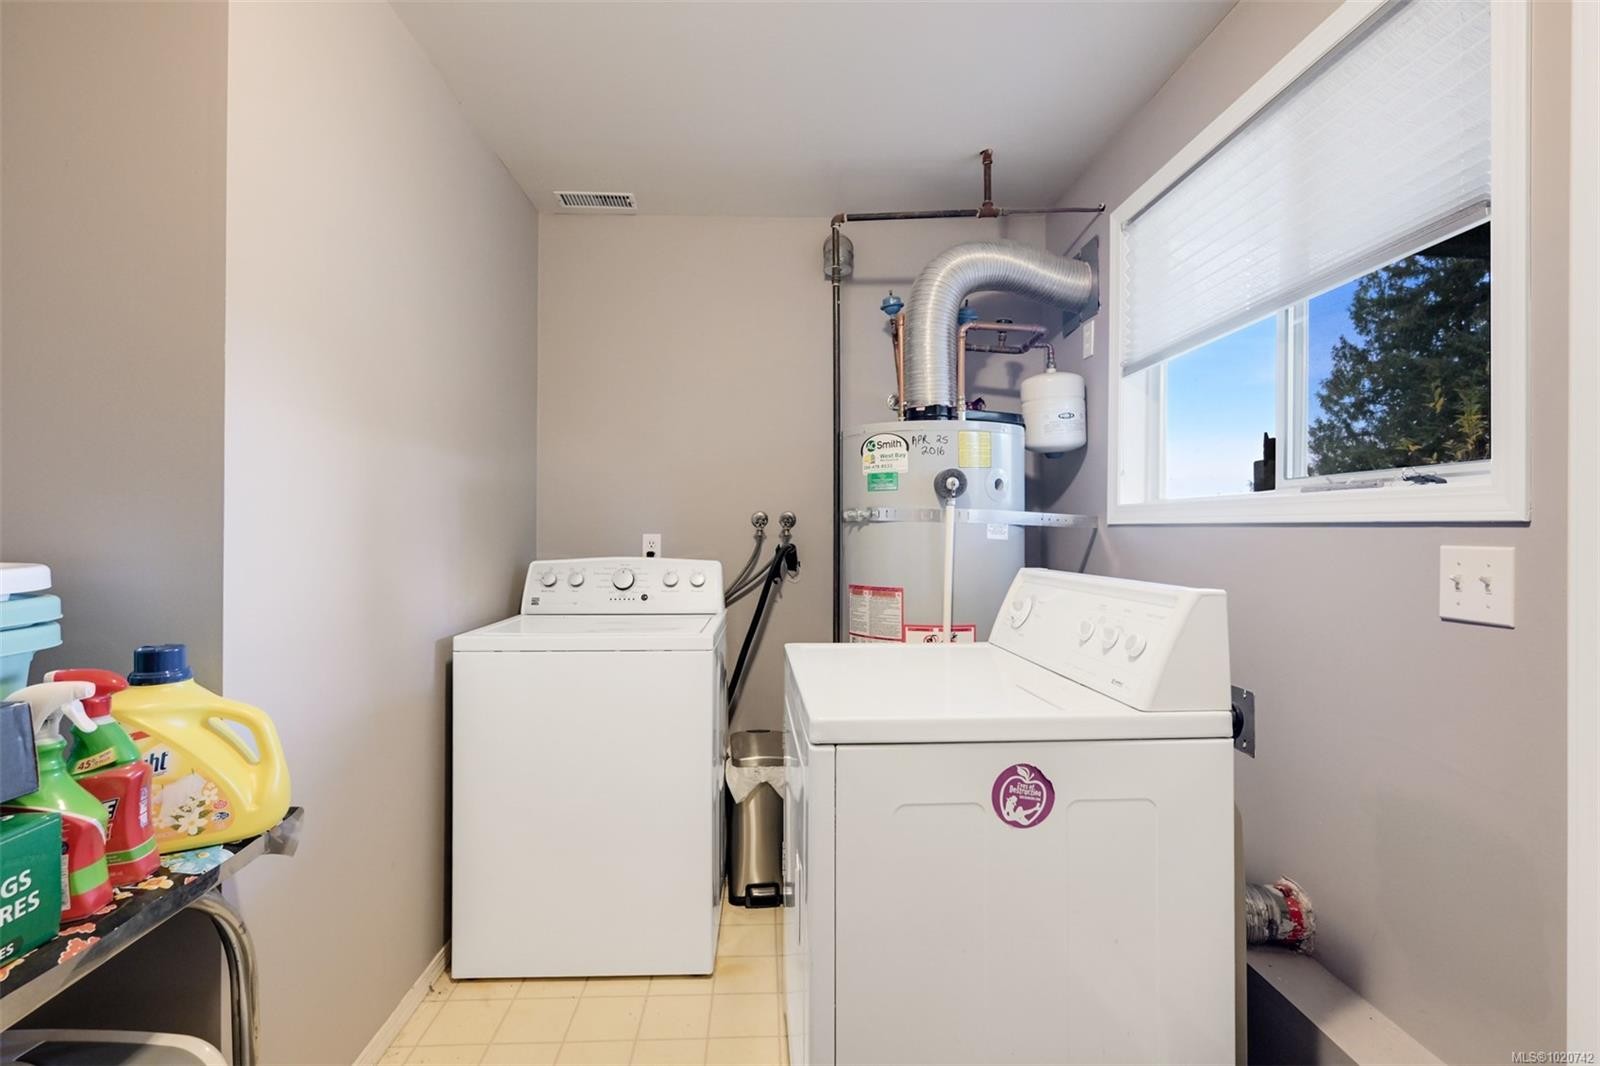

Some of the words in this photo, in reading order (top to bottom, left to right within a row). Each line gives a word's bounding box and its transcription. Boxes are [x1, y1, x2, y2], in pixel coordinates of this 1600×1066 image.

[877, 440, 902, 450] Smith
[912, 434, 931, 448] APR
[936, 434, 949, 445] 25
[921, 446, 945, 456] 2016
[145, 751, 168, 772] ht
